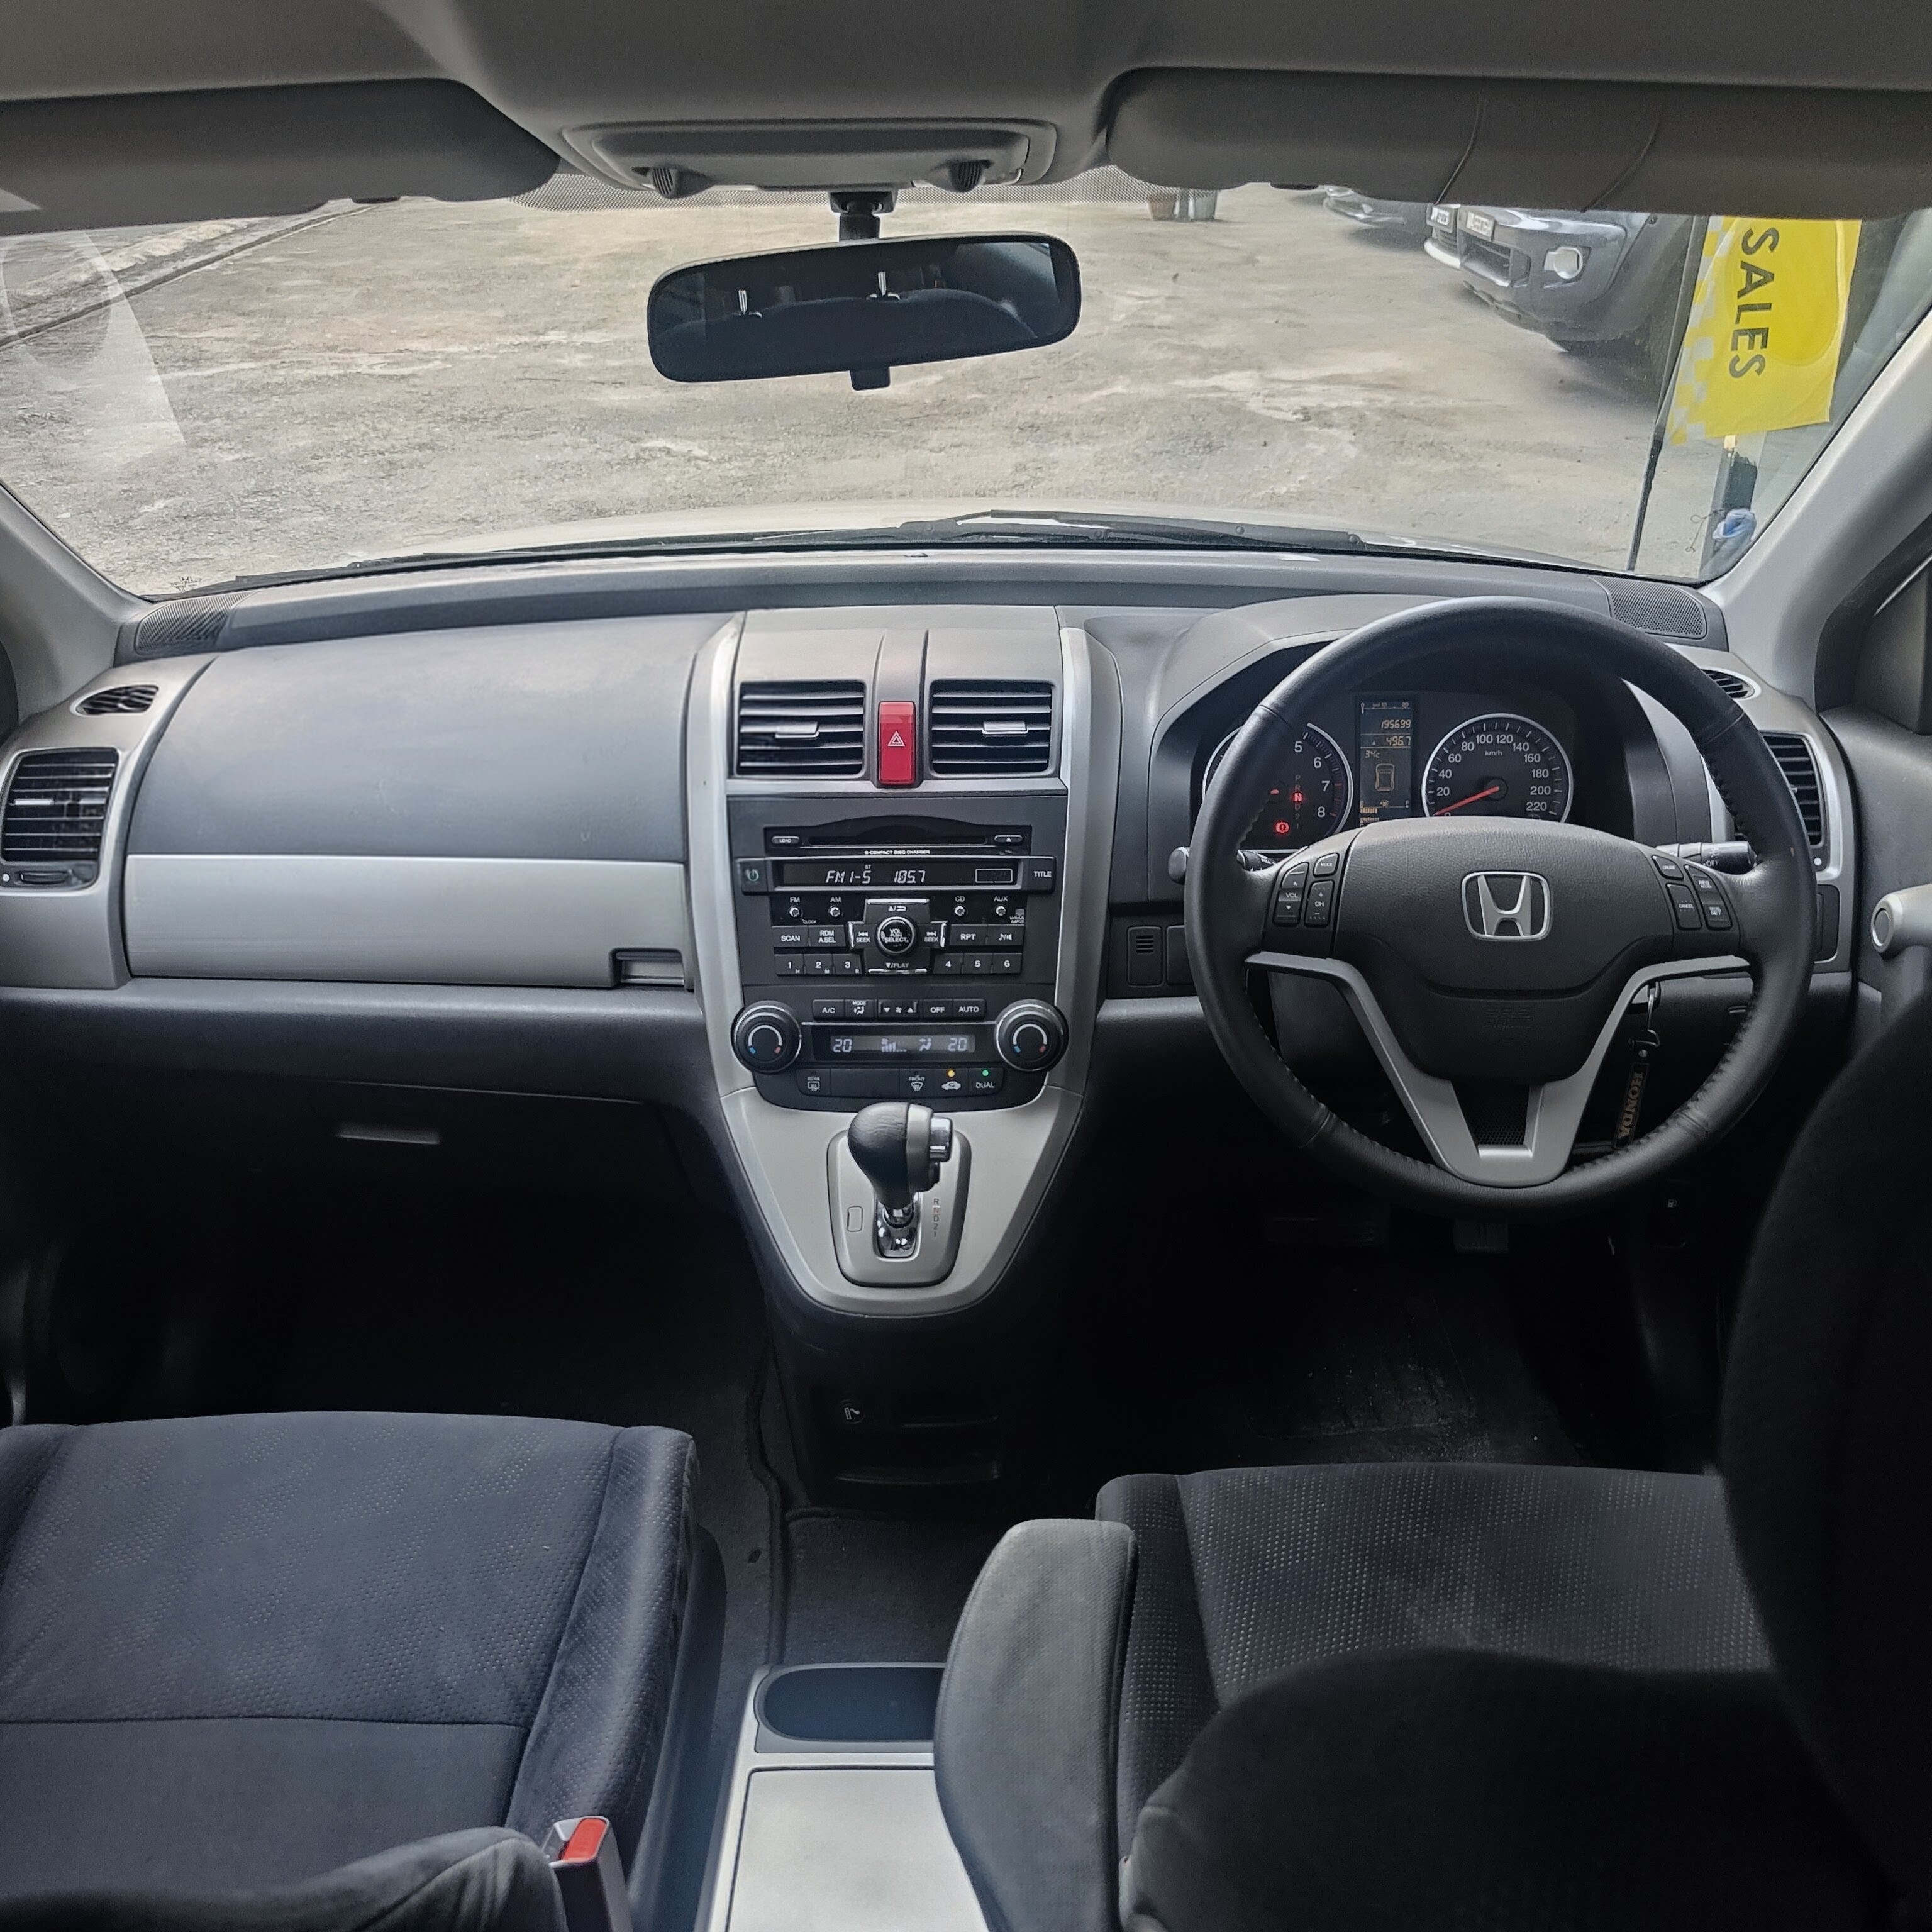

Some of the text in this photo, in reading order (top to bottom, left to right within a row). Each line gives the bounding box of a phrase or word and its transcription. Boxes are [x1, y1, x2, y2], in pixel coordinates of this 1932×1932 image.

[1729, 227, 1779, 378] SALES
[1381, 719, 1411, 729] 195699
[1476, 734, 1493, 744] 100
[1496, 734, 1513, 744] 120
[1294, 741, 1302, 753] 5
[1462, 741, 1475, 751] 80
[1513, 742, 1530, 752] 140
[1313, 757, 1321, 768] 6
[1448, 753, 1462, 763] 60
[1524, 753, 1541, 763] 160
[1438, 769, 1452, 779] 40
[1532, 769, 1549, 778] 180
[1321, 780, 1330, 792] 7
[1530, 786, 1551, 795] 200
[1294, 792, 1302, 801] N
[1436, 787, 1450, 796] 20
[1526, 801, 1546, 811] 220
[1317, 806, 1325, 818] 8
[1004, 960, 1010, 968] 6
[833, 1038, 852, 1053] 20
[948, 1038, 968, 1052] 20
